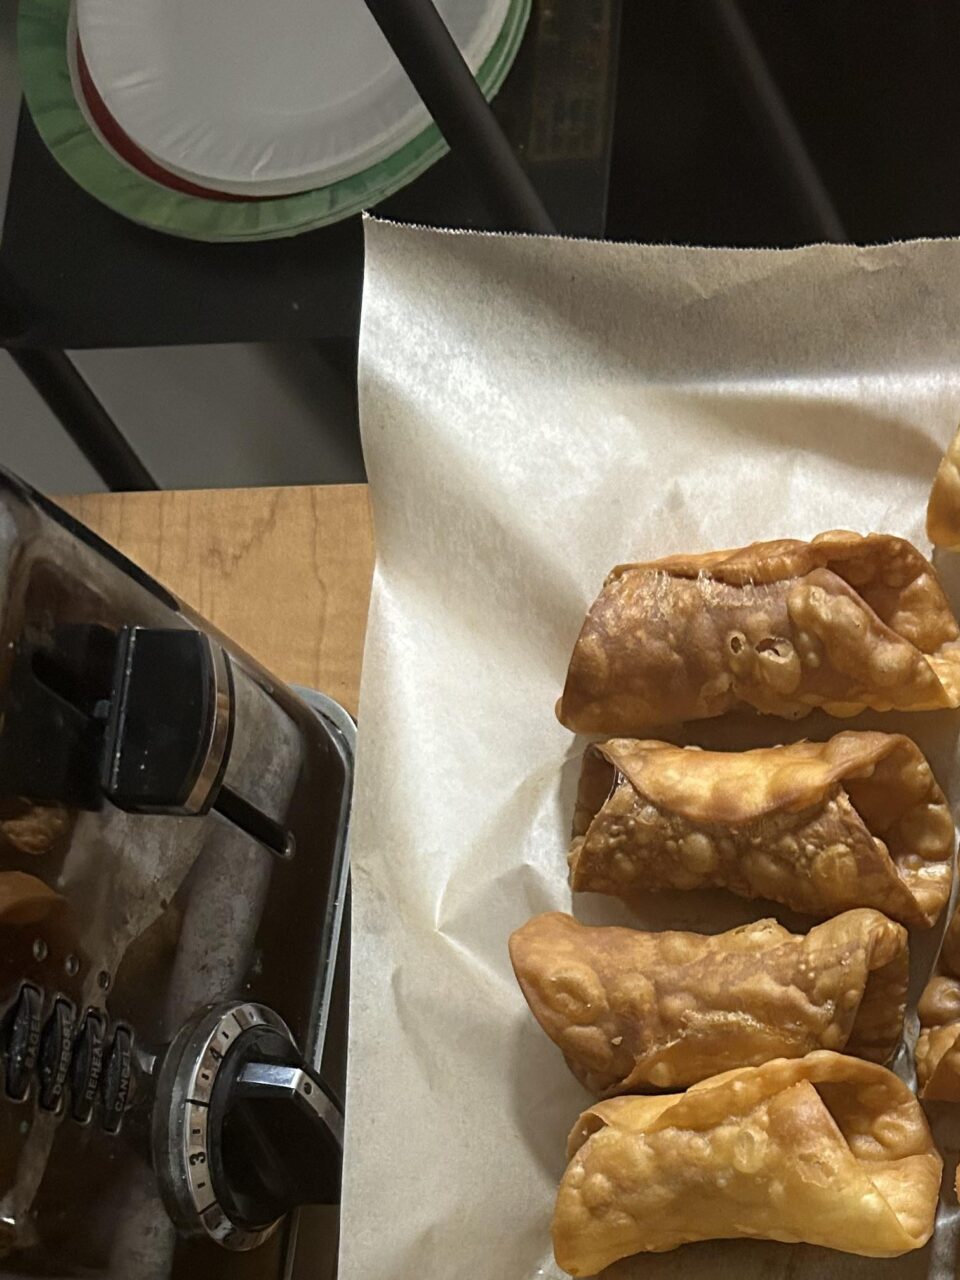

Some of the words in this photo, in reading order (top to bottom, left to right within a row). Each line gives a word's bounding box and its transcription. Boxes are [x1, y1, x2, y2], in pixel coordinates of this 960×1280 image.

[53, 1015, 73, 1095] DEFROST
[86, 1034, 102, 1100] REHEAT
[115, 1050, 131, 1112] CANCEL
[209, 1047, 225, 1061] 4
[189, 1151, 206, 1166] 3
